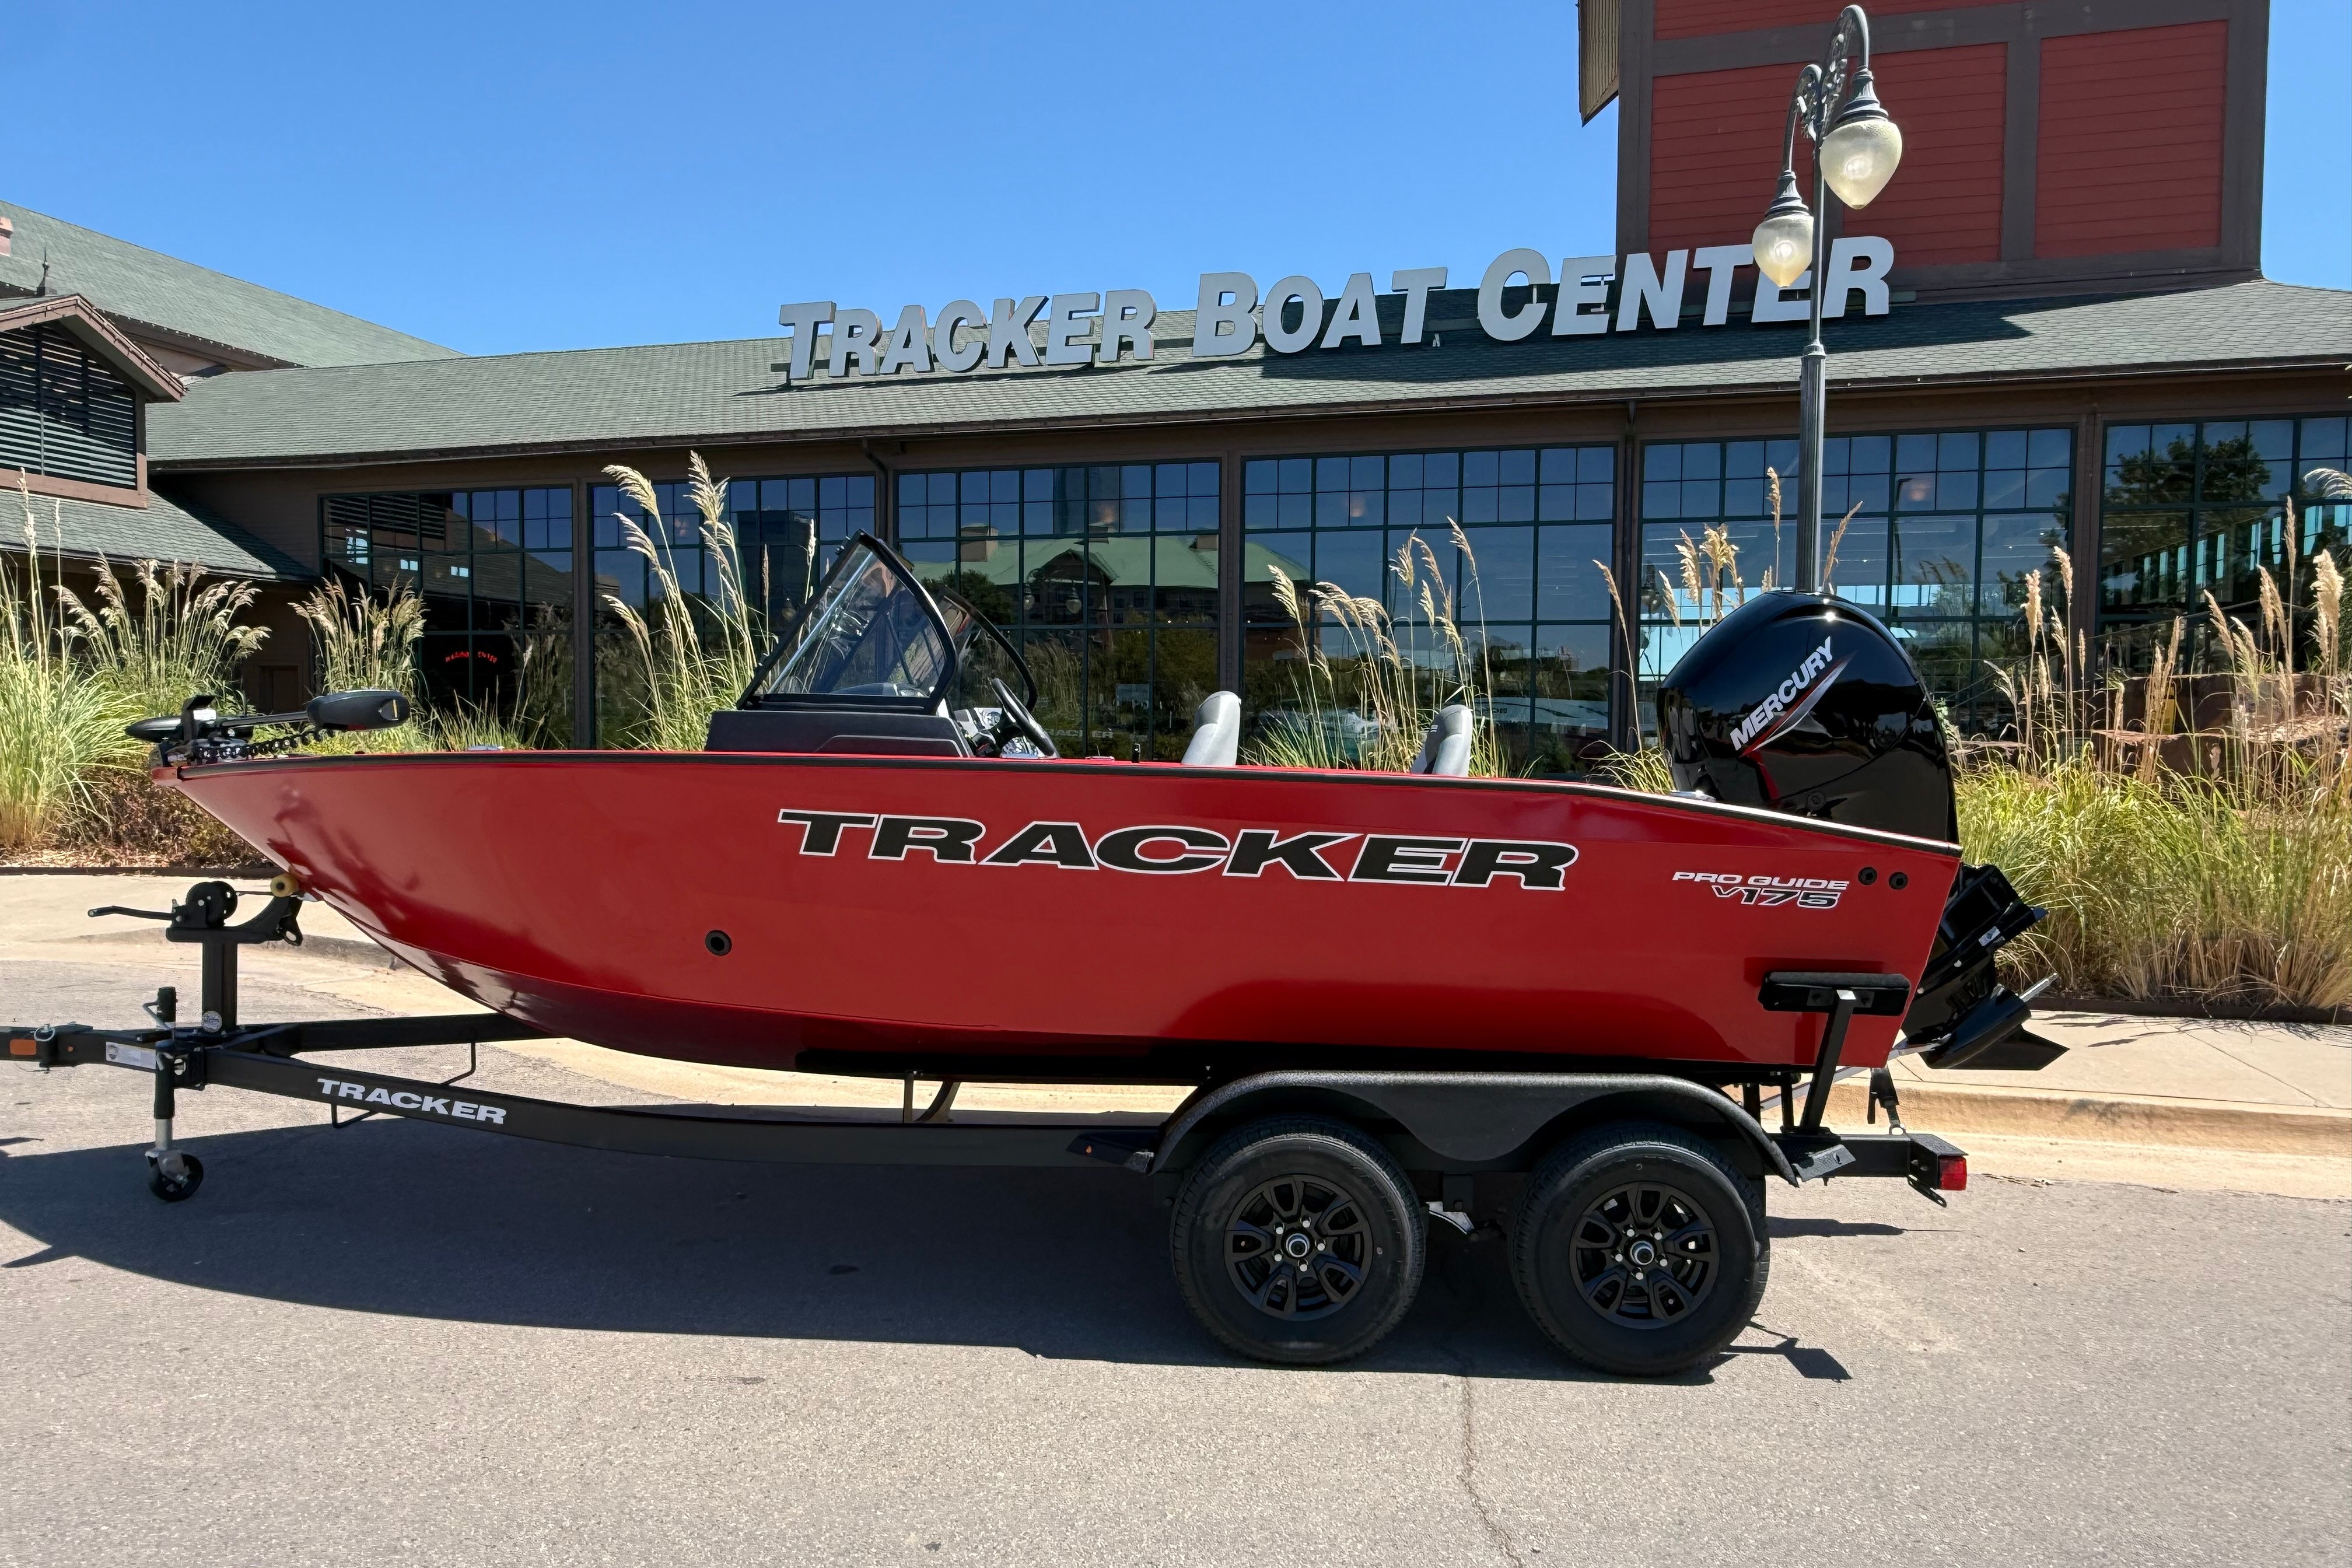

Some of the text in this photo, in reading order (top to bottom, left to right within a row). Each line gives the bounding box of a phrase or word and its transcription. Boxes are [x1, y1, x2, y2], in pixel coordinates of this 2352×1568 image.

[779, 288, 1157, 380] TRACKER
[1192, 267, 1448, 358] BOAT
[1729, 636, 1834, 751] MERCURY
[778, 808, 1580, 892] TRACKER
[1672, 872, 1850, 890] PRO GUIDE
[1711, 885, 1842, 909] V175
[317, 1078, 507, 1125] TRACKER
